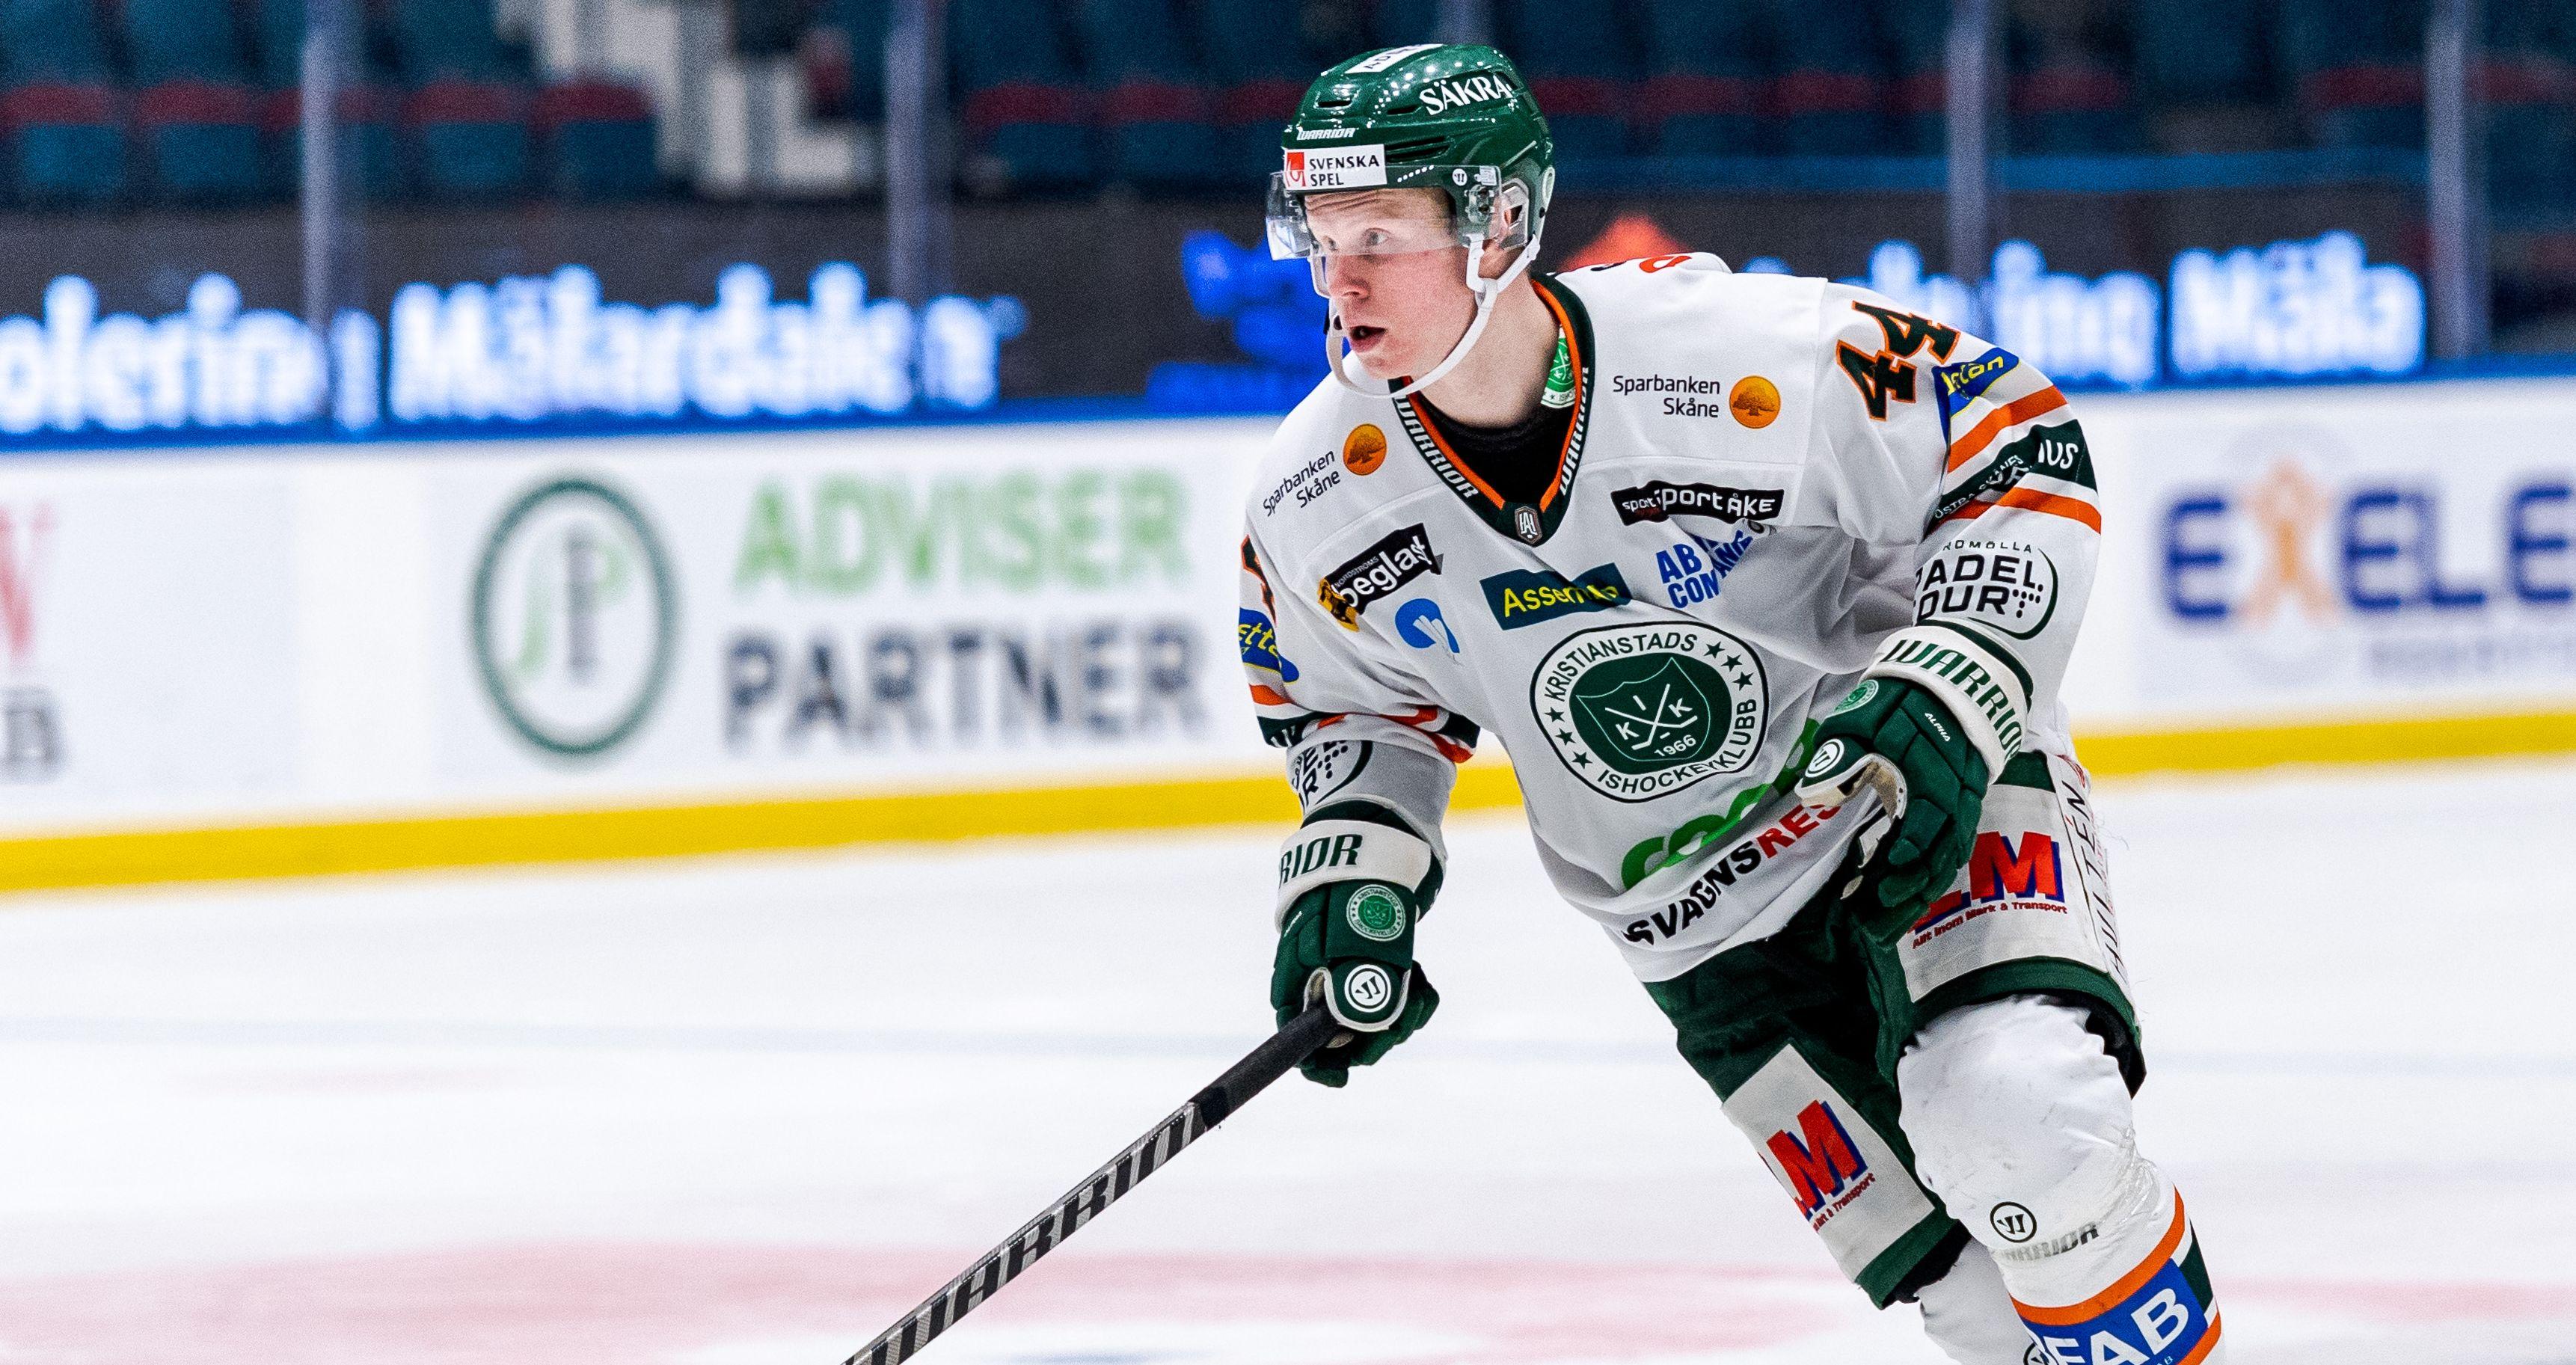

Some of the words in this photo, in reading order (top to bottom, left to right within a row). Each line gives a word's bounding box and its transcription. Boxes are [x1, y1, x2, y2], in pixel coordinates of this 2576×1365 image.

[1296, 128, 1356, 141] WARRIOR
[1309, 155, 1380, 171] SVENSKA
[1310, 173, 1344, 187] SPEL
[1836, 301, 1961, 422] 44
[1613, 375, 1720, 396] Sparbanken
[1663, 397, 1720, 418] Skåne
[1263, 450, 1336, 518] Sparbanken
[1296, 470, 1341, 509] Skåne
[733, 471, 1195, 595] ADVISER
[1655, 544, 1702, 583] AB
[724, 610, 1208, 754] PARTNER
[1544, 631, 1699, 702] KRISTIANSTADS
[1596, 698, 1758, 795] ISHOCKEYKLUBB
[1654, 734, 1697, 758] 1966
[2011, 901, 2068, 914] Transport
